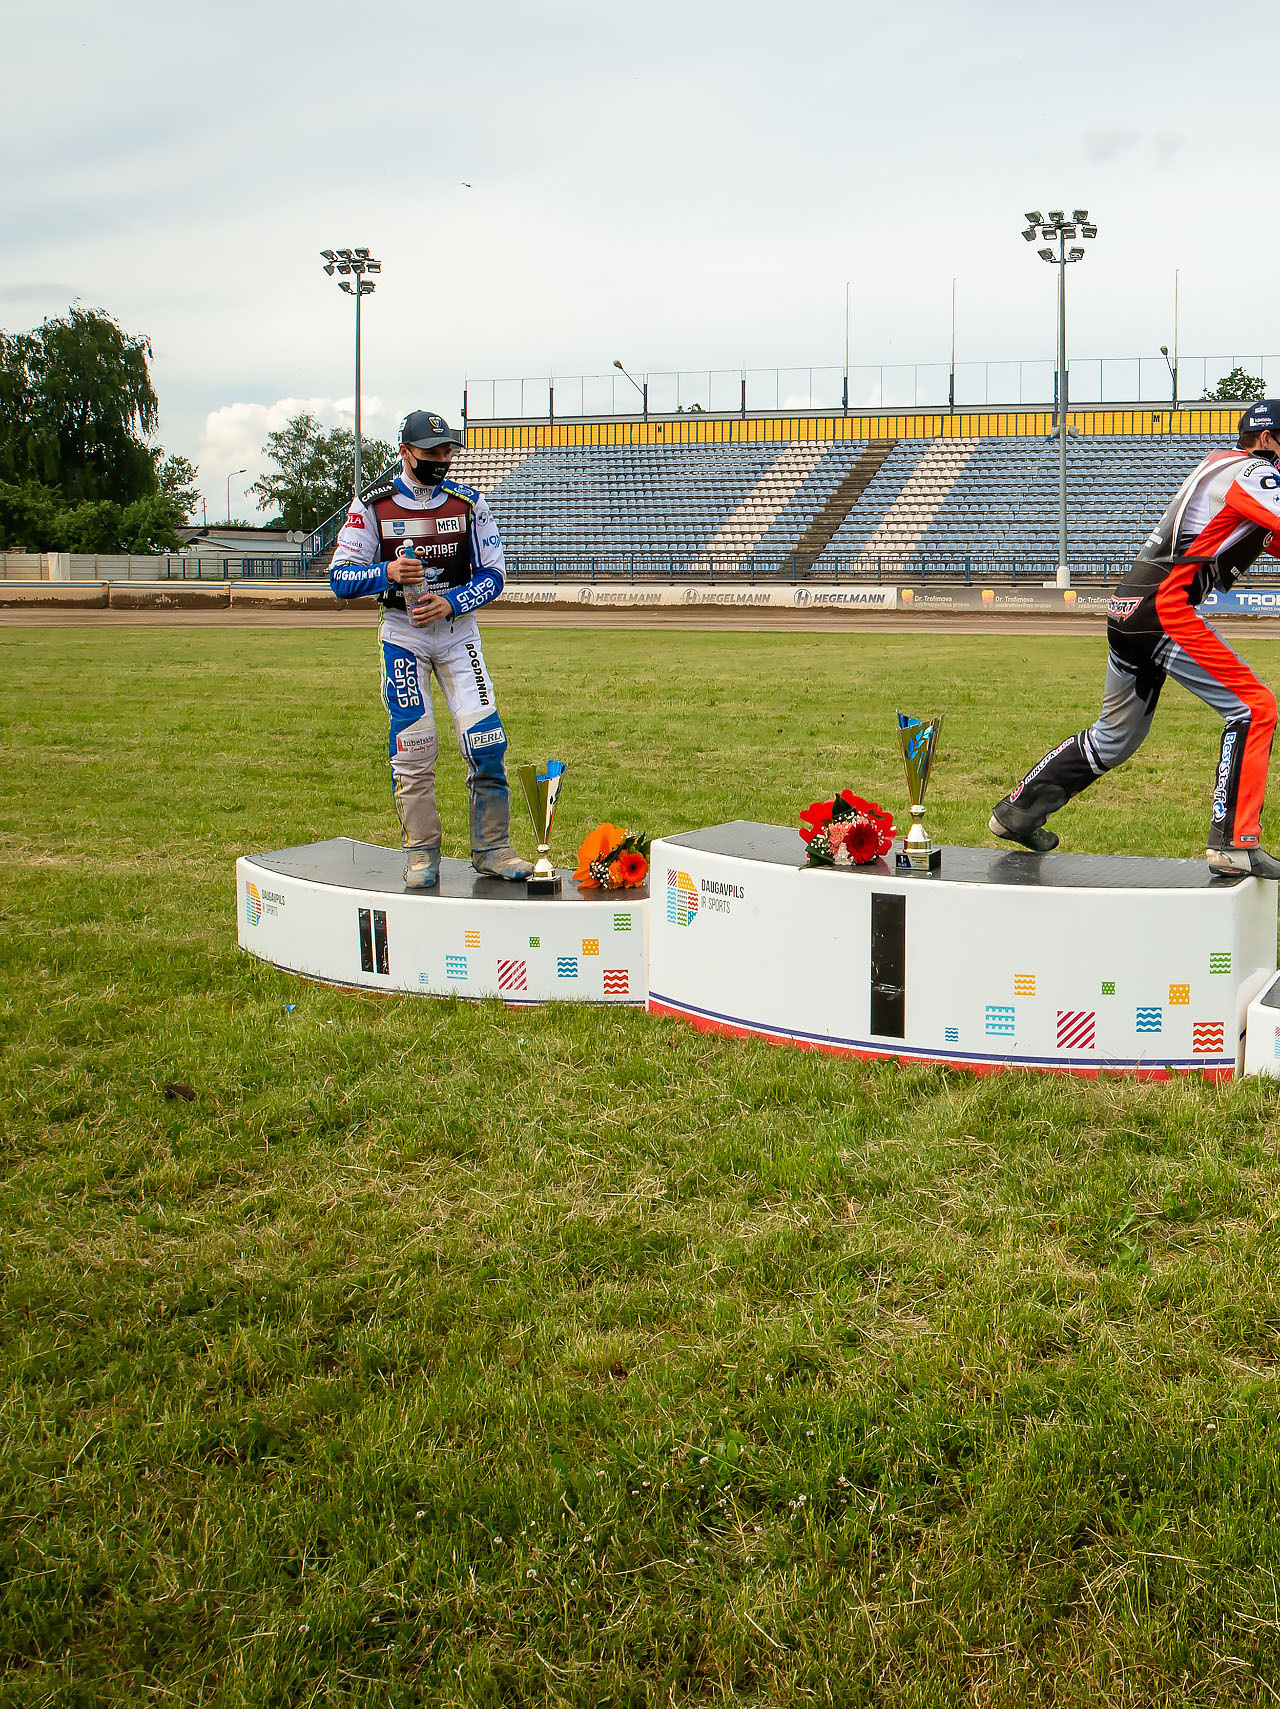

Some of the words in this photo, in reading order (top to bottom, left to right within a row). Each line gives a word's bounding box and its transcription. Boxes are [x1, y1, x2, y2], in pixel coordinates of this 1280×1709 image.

[1153, 414, 1161, 423] M
[361, 484, 393, 502] CANAL+
[437, 519, 458, 532] MFR
[596, 593, 661, 603] HEGELMANN
[701, 593, 771, 603] HEGELMANN
[813, 593, 885, 604] HEGELMANN
[464, 643, 490, 706] BOGDANKA
[701, 878, 745, 899] DAUGAVPILS
[708, 897, 731, 914] SPORTS
